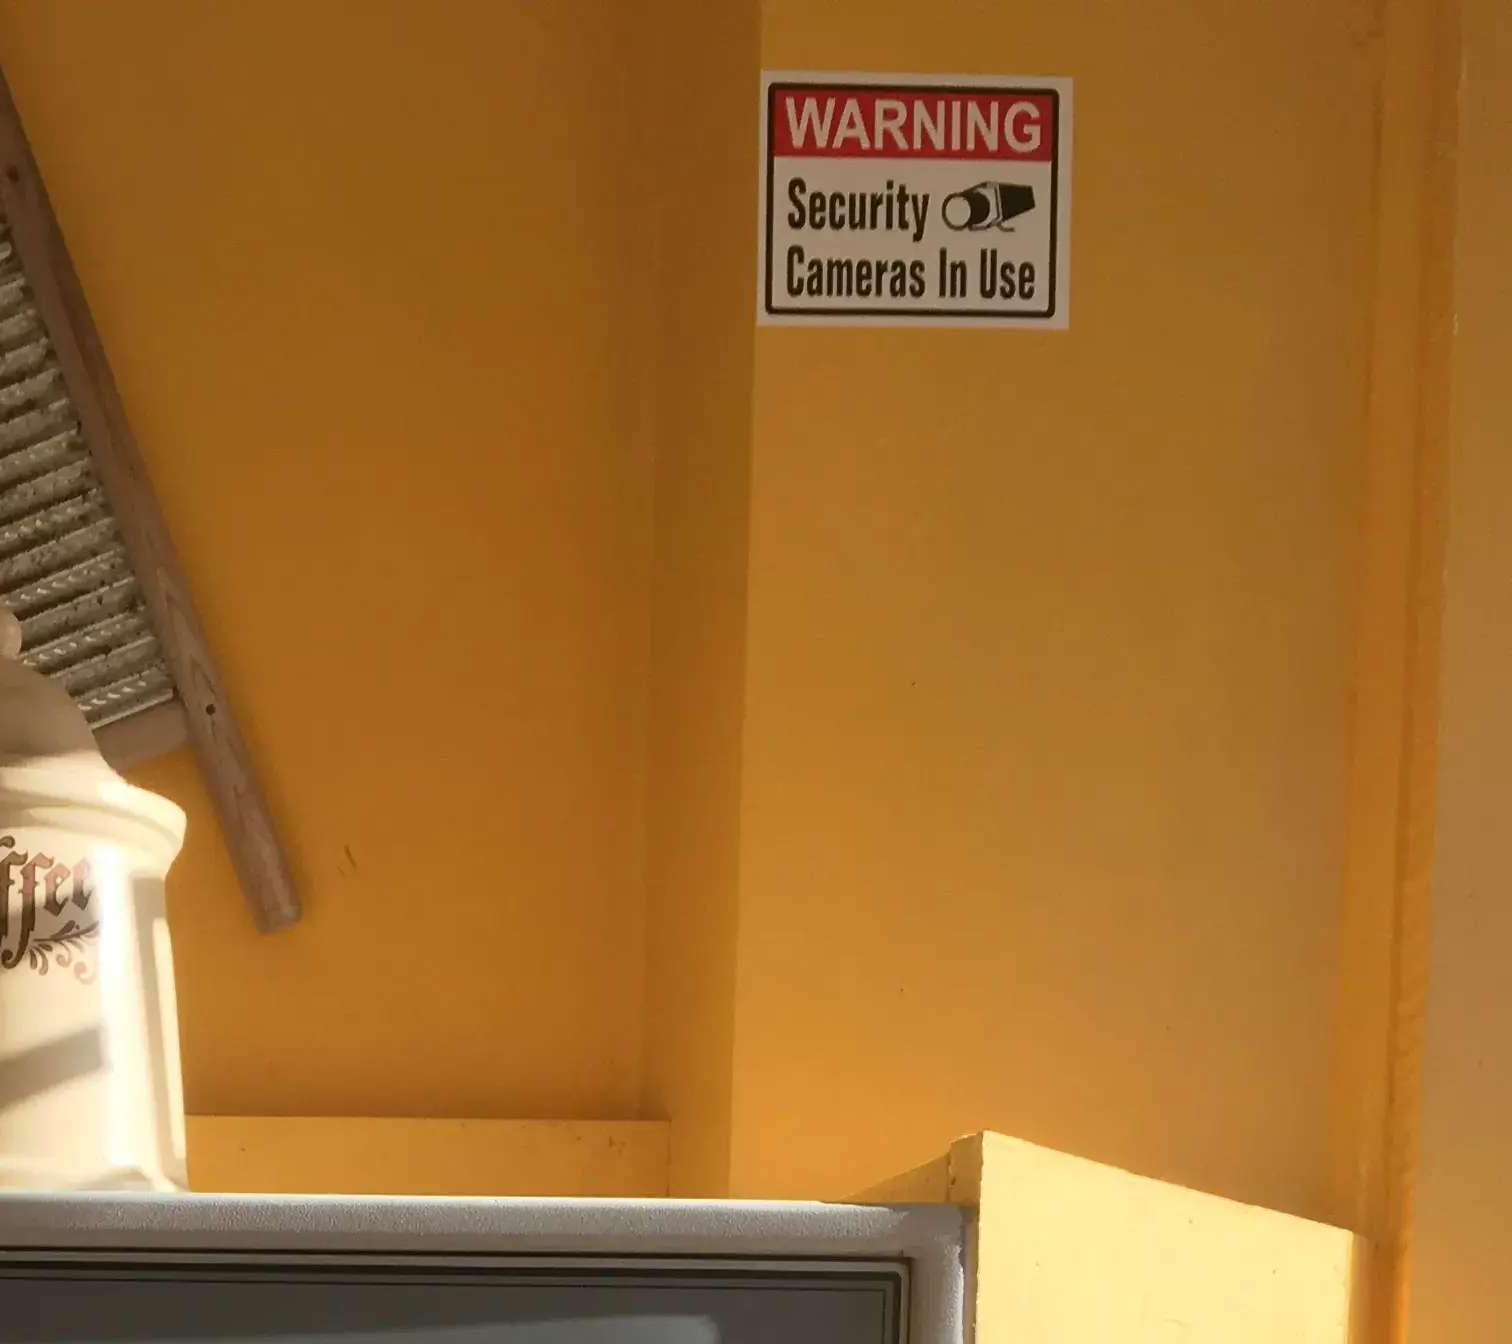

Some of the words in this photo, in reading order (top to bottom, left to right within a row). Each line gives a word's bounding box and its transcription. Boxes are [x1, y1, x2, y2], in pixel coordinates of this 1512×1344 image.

[785, 96, 1041, 153] WARNING
[788, 177, 930, 243] Security
[787, 245, 926, 298] Cameras
[939, 247, 967, 298] In
[980, 248, 1036, 300] Use
